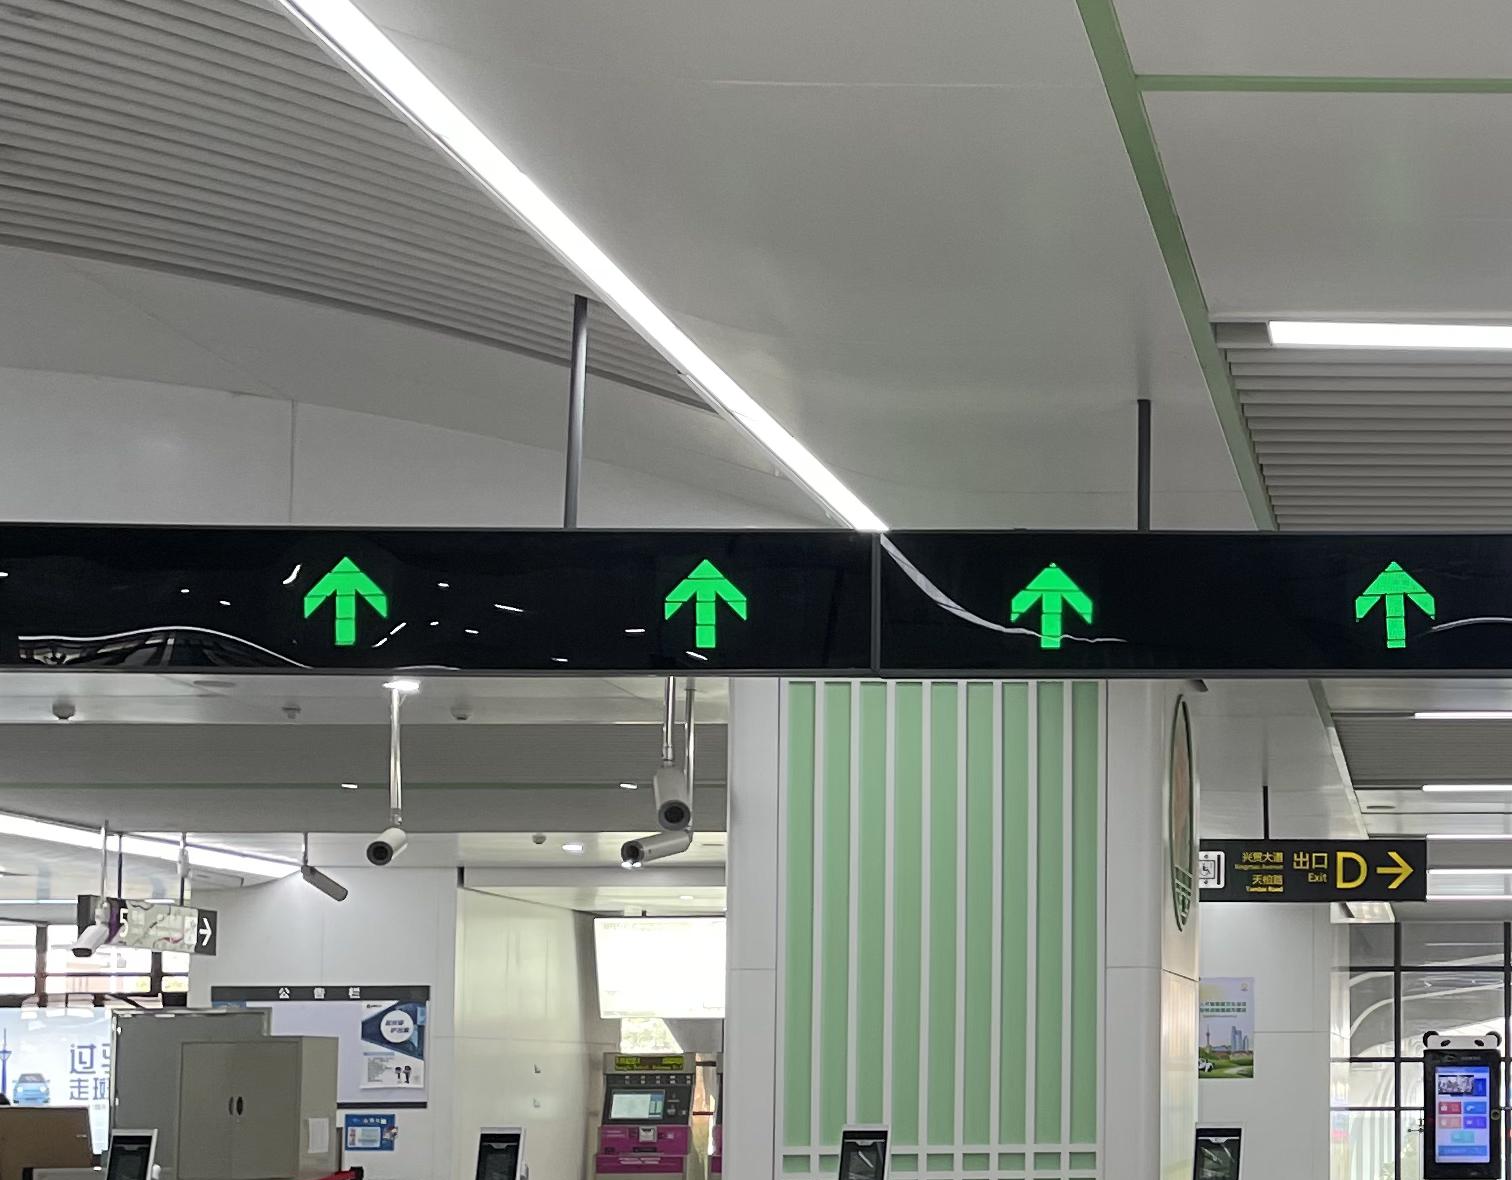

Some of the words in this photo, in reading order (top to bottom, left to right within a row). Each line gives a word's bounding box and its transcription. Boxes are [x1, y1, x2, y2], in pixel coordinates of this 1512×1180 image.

[1292, 851, 1329, 870] 出口
[1336, 851, 1368, 889] D
[1307, 873, 1328, 883] Exit
[119, 908, 128, 938] 5
